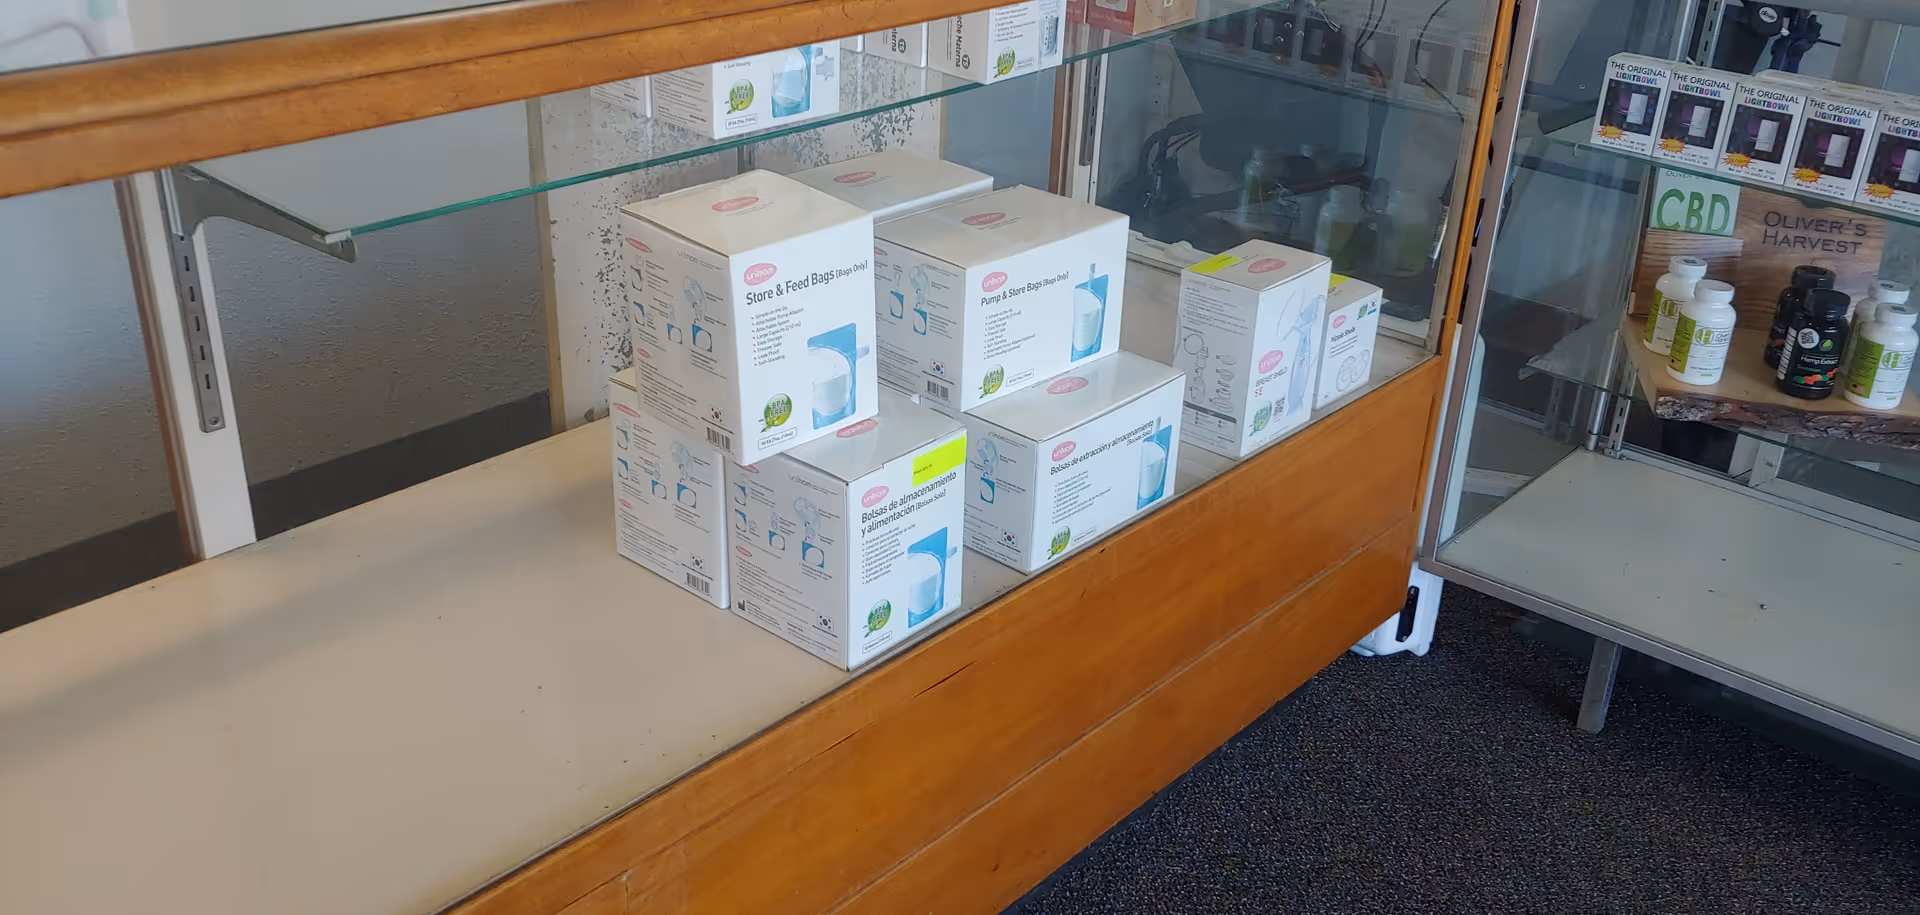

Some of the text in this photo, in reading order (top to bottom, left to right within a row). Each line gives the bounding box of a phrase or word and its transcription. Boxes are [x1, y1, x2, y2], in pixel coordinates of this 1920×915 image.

[1611, 61, 1667, 78] THE ORIGINAL
[1616, 71, 1658, 85] LIGHTBOWL
[1673, 73, 1731, 90] THE ORIGINAL
[1678, 84, 1721, 98] LIGHTBOWL
[1739, 86, 1799, 104] THE ORIGINAL
[1744, 97, 1790, 112] LIGHTBOWL
[1810, 100, 1872, 119] THE ORIGINAL
[1815, 110, 1862, 126] LIGHTBOWL
[1883, 114, 1900, 124] THE
[1656, 188, 1730, 233] CBD
[1763, 211, 1867, 237] OLIVER'S
[1762, 229, 1863, 255] HARVEST
[746, 288, 773, 305] Store
[776, 283, 784, 297] &
[785, 275, 809, 293] Feed
[811, 270, 834, 285] Bags
[981, 294, 1000, 306] Pump
[1002, 291, 1007, 300] &
[1008, 286, 1026, 298] Store
[1026, 280, 1042, 292] Bags
[1800, 355, 1820, 365] Hemp
[770, 405, 787, 417] FREE
[771, 399, 786, 409] BPA
[1050, 461, 1071, 475] Bolsas
[1071, 456, 1078, 465] de
[1112, 420, 1154, 447] almacenamiento
[861, 471, 957, 523] Bolsas de almacenamiento
[861, 529, 867, 538] y
[867, 504, 915, 533] alimentación
